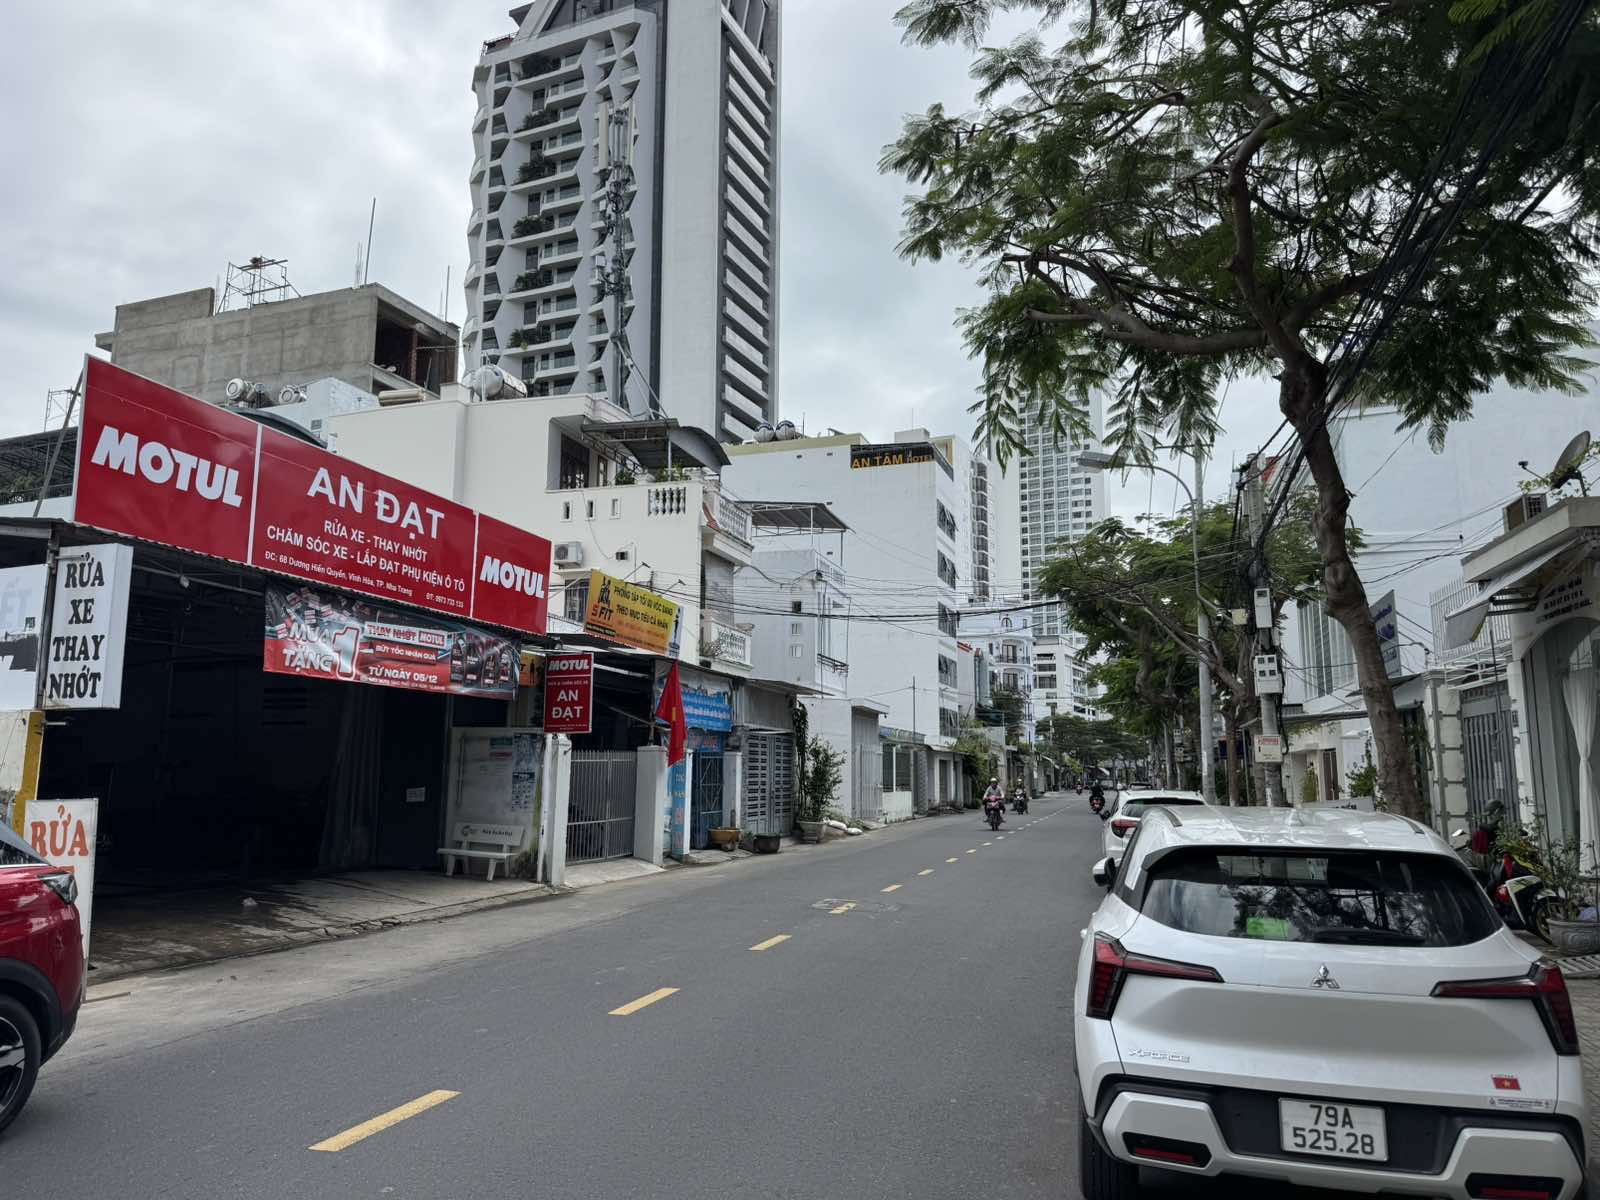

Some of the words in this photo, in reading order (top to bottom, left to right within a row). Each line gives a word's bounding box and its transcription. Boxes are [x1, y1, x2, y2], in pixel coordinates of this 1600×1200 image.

[91, 424, 243, 508] MOTUL
[852, 457, 870, 468] AN
[874, 453, 903, 467] TÂM
[307, 466, 364, 514] AN
[375, 489, 446, 540] ĐẠT
[324, 518, 348, 540] RỬA
[350, 528, 365, 544] XE
[373, 535, 401, 554] THAY
[402, 544, 428, 563] NHỚT
[65, 552, 105, 588] RỬA
[265, 550, 279, 562] ĐC:
[266, 524, 303, 548] CHĂM
[306, 535, 330, 555] SÓC
[332, 544, 348, 560] XE
[357, 547, 377, 567] LẮP
[379, 558, 401, 576] ĐẠT
[402, 564, 421, 581] PHỤ
[422, 569, 443, 588] KIỆN
[445, 574, 452, 589] Ô
[453, 577, 465, 592] TÔ
[480, 555, 545, 599] MOTUL
[68, 598, 95, 624] XE
[599, 606, 614, 620] FIT
[53, 634, 105, 662] THAY
[367, 623, 391, 637] THAY
[420, 633, 445, 645] MOTUL
[283, 643, 333, 672] TẶNG
[332, 626, 360, 680] 1
[548, 659, 590, 671] MOTUL
[48, 664, 101, 699] NHỚT
[369, 664, 384, 677] TỪ
[384, 667, 412, 681] NGÀY
[413, 672, 438, 684] 05/12
[557, 689, 579, 702] AN
[551, 706, 584, 721] ĐẠT
[31, 804, 89, 857] RỬA
[1309, 1104, 1354, 1129] 79A
[1292, 1126, 1375, 1155] 525.28
